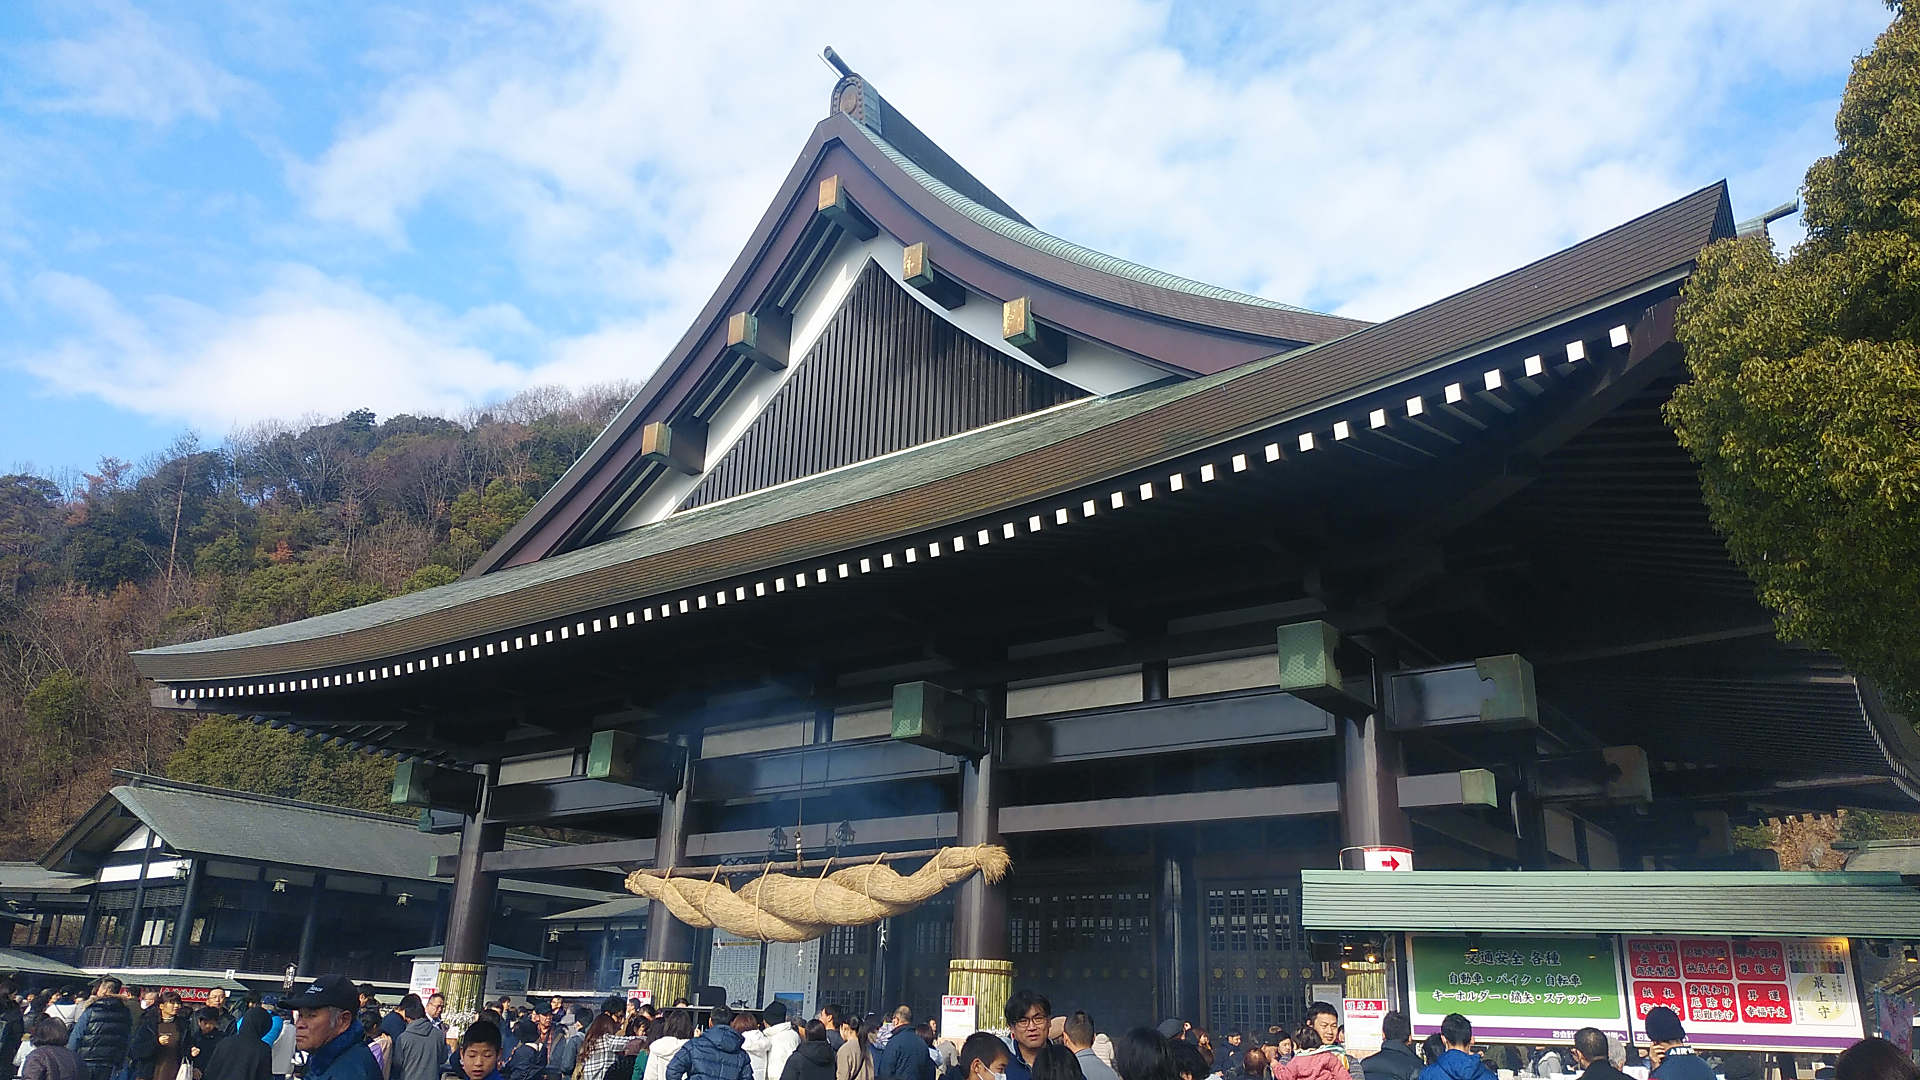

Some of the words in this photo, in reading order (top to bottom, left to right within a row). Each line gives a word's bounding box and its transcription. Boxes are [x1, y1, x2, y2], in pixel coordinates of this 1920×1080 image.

[1465, 950, 1525, 966] 交通安全
[1529, 951, 1562, 966] 各種
[1448, 972, 1582, 987] 自動車・バイク・自転車
[1432, 989, 1602, 1005] キーホルダー・鏑矢・ステッカー
[1689, 984, 1730, 995] 身代わり
[1812, 975, 1831, 1019] 最上守
